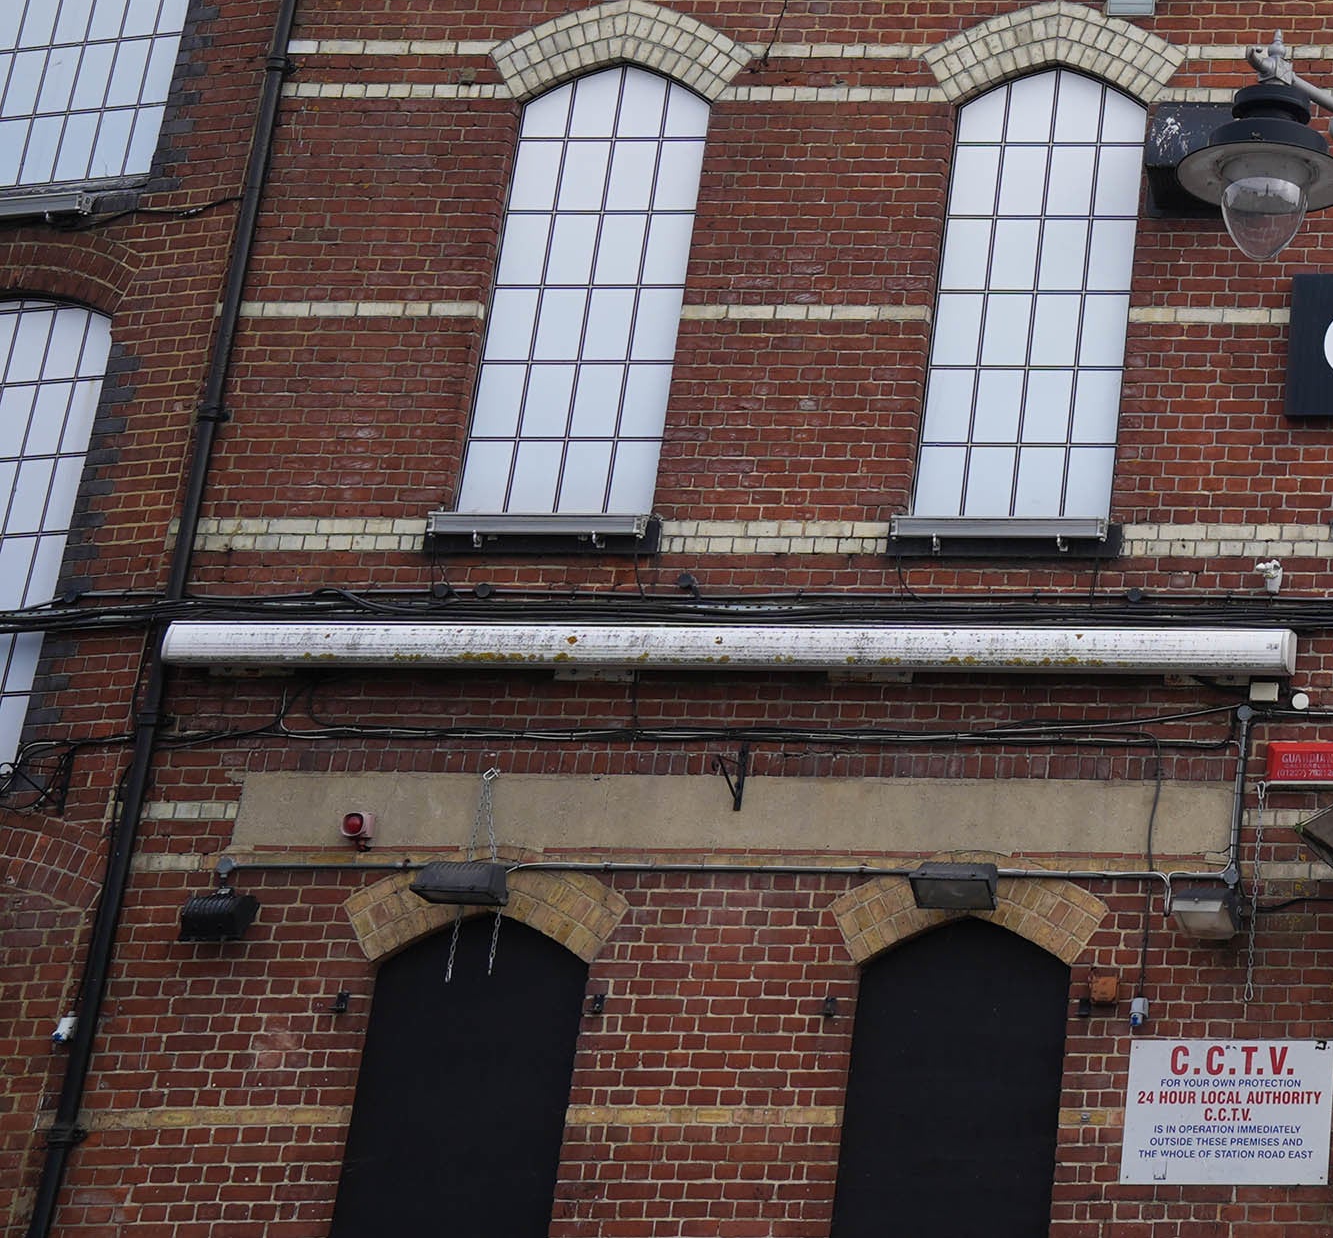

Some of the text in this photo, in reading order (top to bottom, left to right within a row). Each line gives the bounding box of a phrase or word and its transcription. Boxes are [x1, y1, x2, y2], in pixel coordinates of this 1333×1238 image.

[1170, 1045, 1294, 1075] C.C.T.V.
[1160, 1079, 1302, 1088] FOR YOUR OWN PROTECTION
[1137, 1090, 1322, 1104] 24 HOUR LOCAL AUTHORITY
[1204, 1107, 1252, 1121] C.C.T.V.
[1154, 1125, 1301, 1134] IS IN OPERATION IMMEDIATELY
[1149, 1137, 1303, 1146] OUTSIDE THESE PREMISES AND
[1139, 1149, 1314, 1159] THE WHOLE OF STATION ROAD EAST
